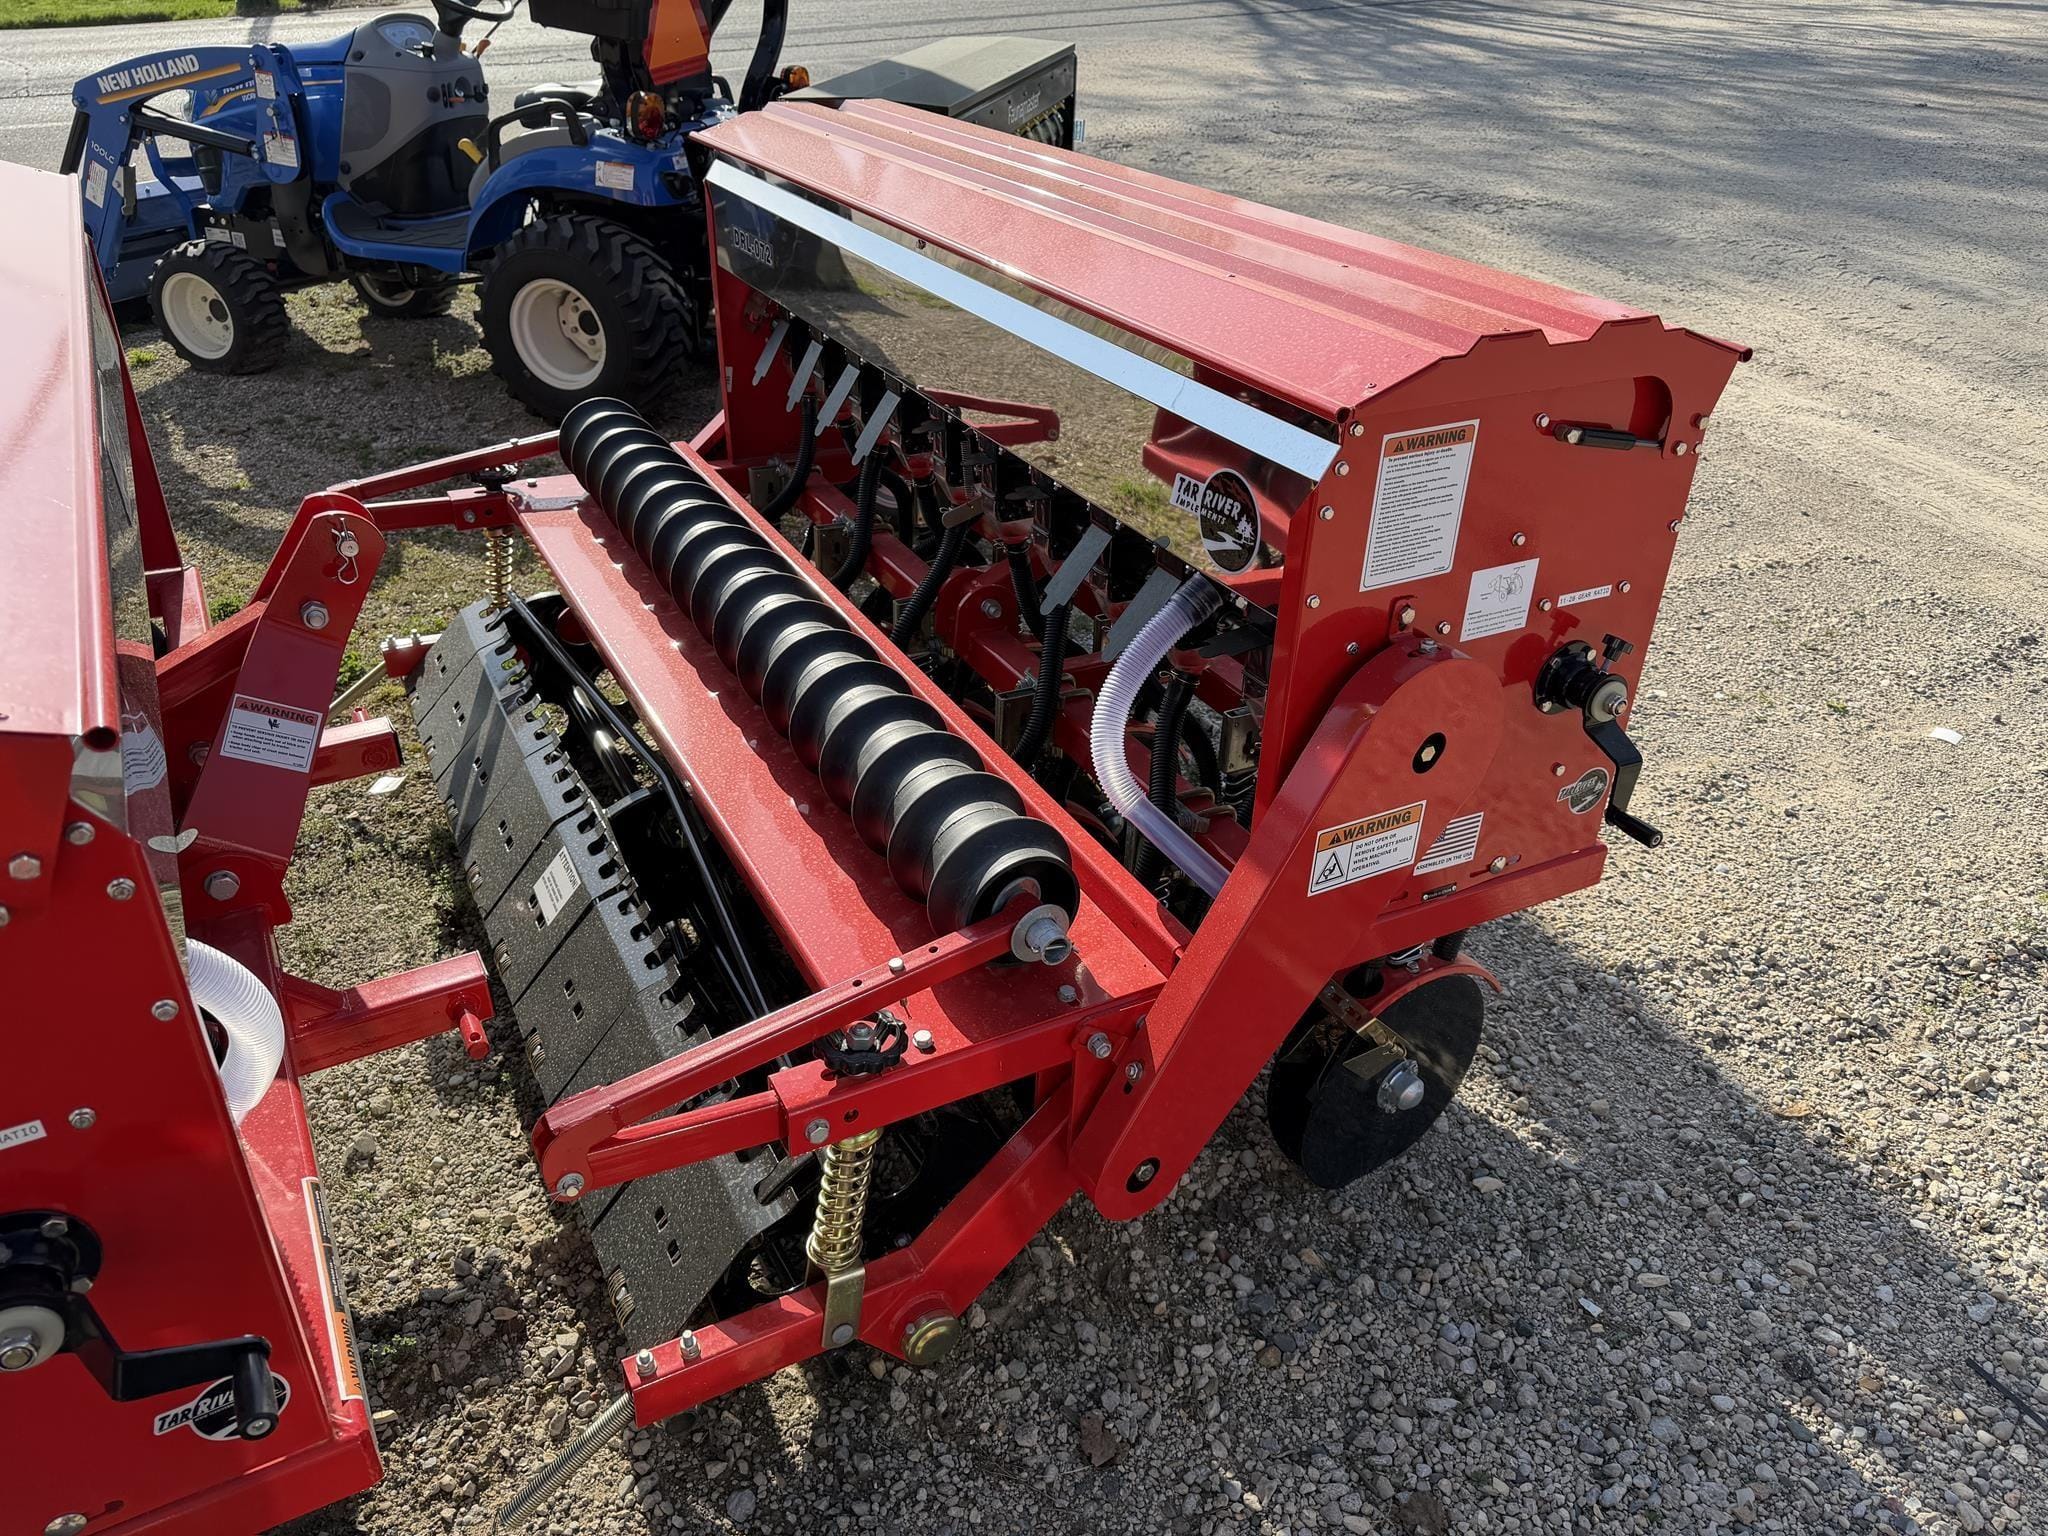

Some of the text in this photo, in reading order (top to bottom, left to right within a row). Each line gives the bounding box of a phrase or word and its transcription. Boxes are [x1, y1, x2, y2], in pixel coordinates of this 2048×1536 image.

[97, 54, 200, 94] NEW HOLLAND
[91, 141, 115, 165] 100LC
[733, 227, 773, 266] DRL-072
[1407, 429, 1466, 450] WARNING
[1175, 495, 1227, 525] IMPLEMENTS
[1177, 477, 1242, 520] TAR RIVER
[1578, 592, 1591, 600] GEAR
[1594, 587, 1610, 596] RATIO
[250, 703, 314, 724] WARNING
[1343, 811, 1412, 841] WARNING
[1354, 835, 1412, 857] REMOVE SAFETY SHIELD
[1375, 836, 1390, 845] OPEN
[1353, 857, 1368, 865] WHEN
[1369, 850, 1392, 861] MACHINE
[1416, 859, 1445, 870] ASSEMBLED
[559, 851, 578, 889] ATTENTION!
[158, 1407, 193, 1433] TAR
[198, 1390, 235, 1416] RIV
